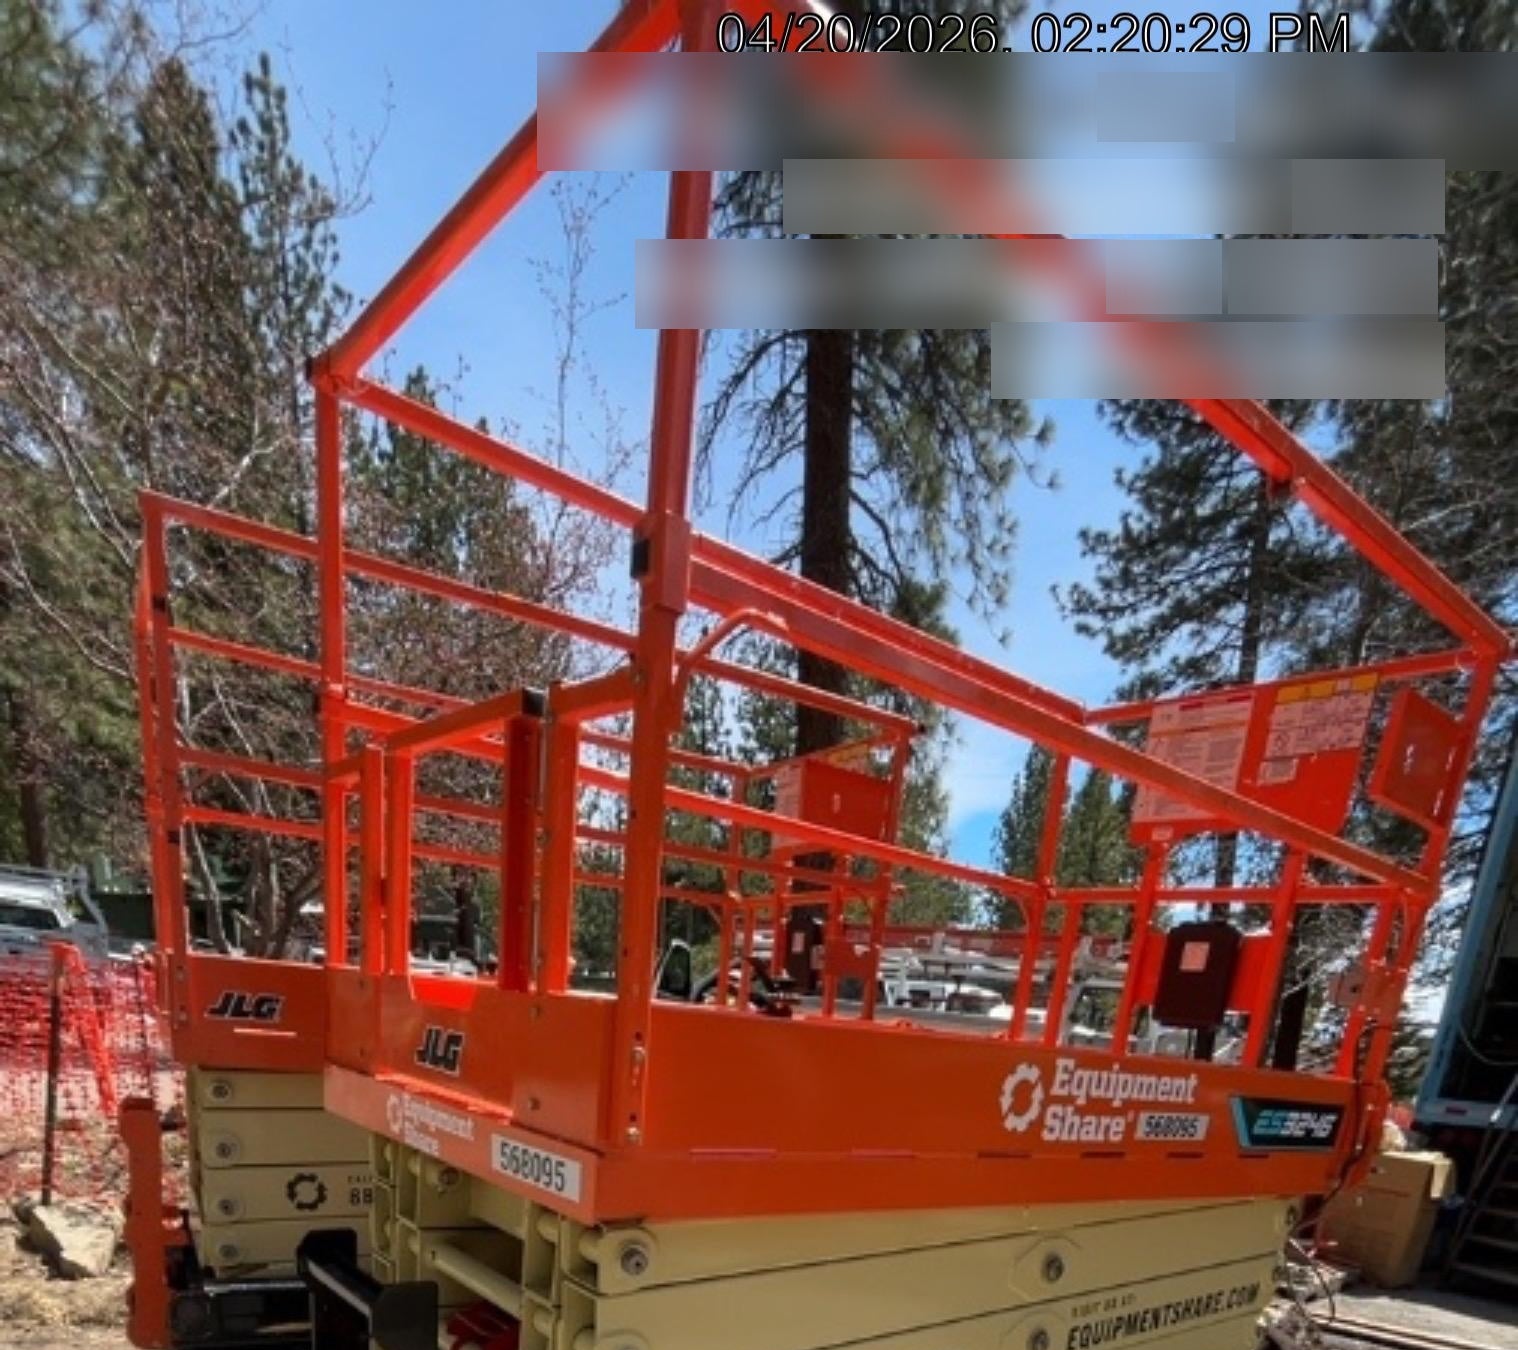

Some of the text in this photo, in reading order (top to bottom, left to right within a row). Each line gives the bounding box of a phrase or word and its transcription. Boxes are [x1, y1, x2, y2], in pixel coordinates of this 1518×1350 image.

[204, 990, 285, 1022] JLG
[414, 1025, 465, 1076] JLG
[1052, 1057, 1198, 1107] Equipment
[1042, 1104, 1128, 1142] Share
[500, 1141, 566, 1192] 568095
